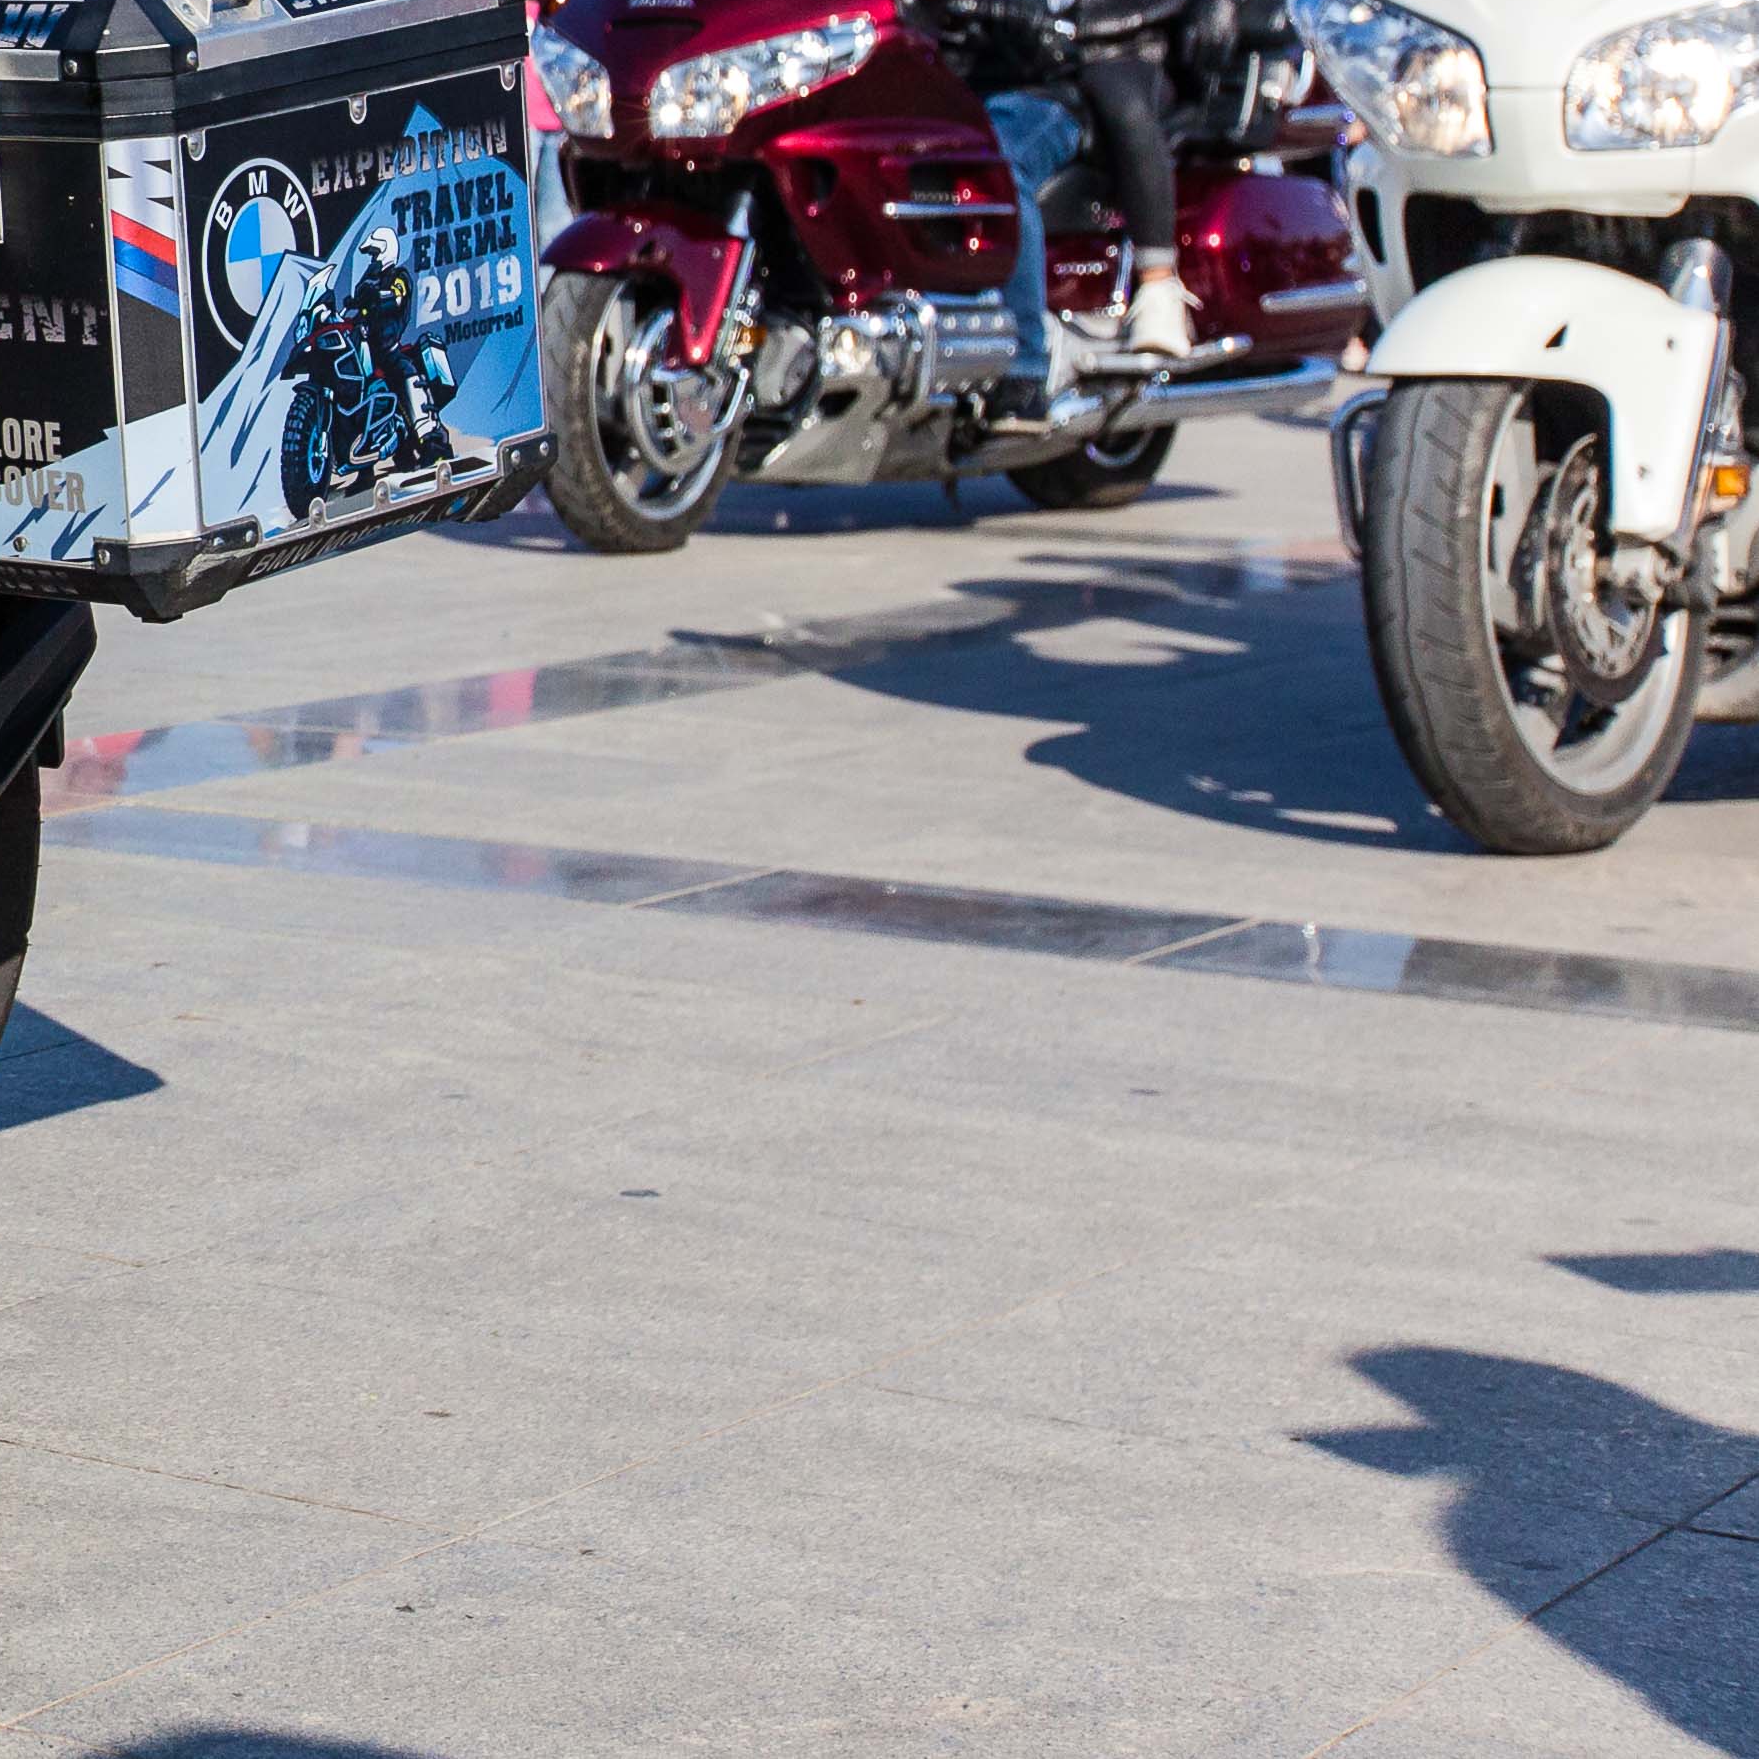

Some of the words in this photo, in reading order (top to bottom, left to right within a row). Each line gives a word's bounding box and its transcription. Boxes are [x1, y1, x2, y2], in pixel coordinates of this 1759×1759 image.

[311, 118, 508, 197] EXPEDITION
[215, 170, 305, 230] BMW
[391, 171, 513, 236] TRAVEL
[416, 255, 523, 329] 2019
[443, 305, 524, 346] Motorrad
[248, 537, 323, 577] BMW
